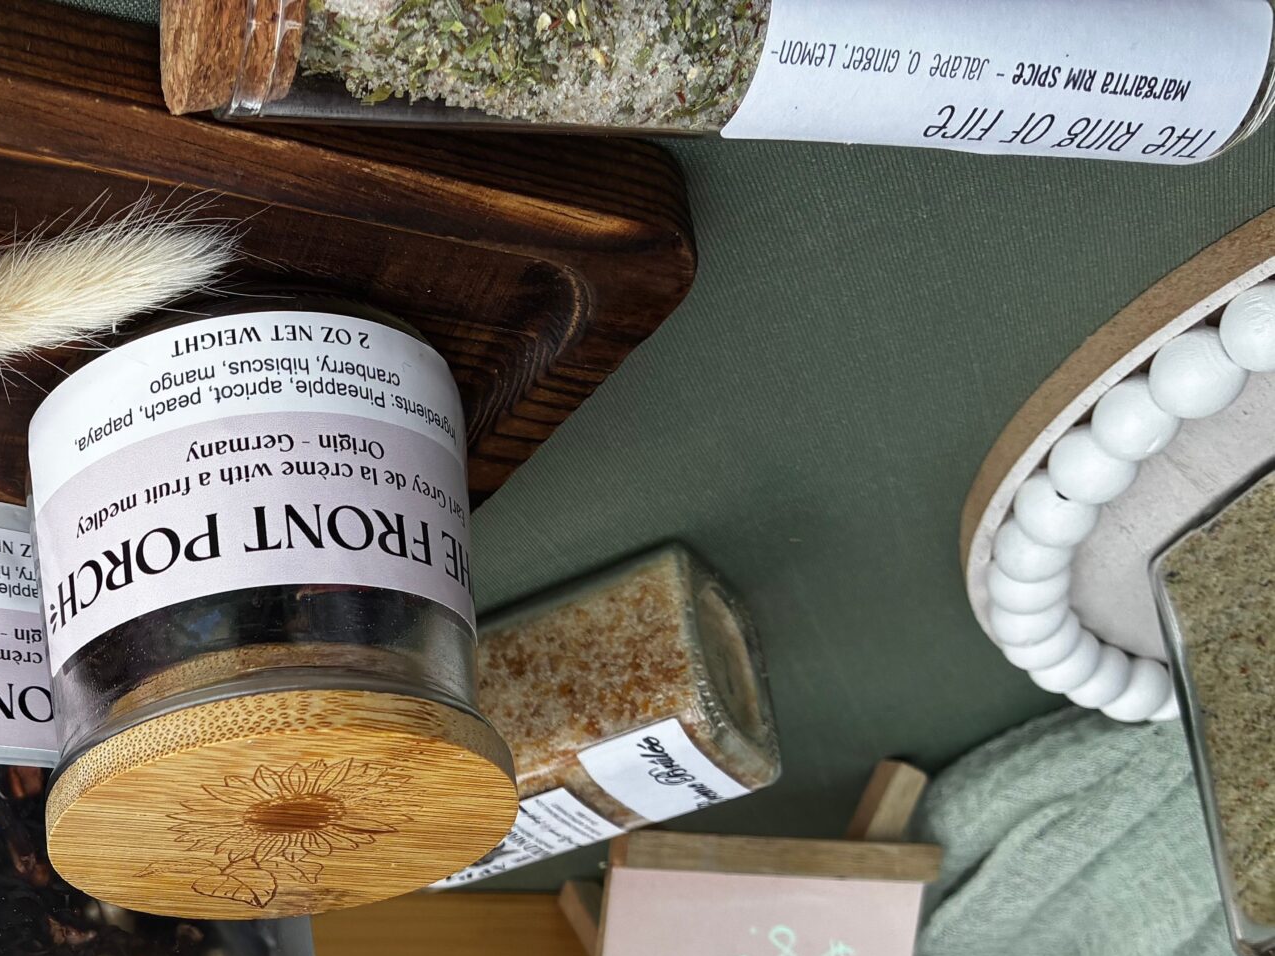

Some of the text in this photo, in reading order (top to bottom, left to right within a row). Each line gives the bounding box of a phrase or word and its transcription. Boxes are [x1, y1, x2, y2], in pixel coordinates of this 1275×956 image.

[170, 324, 370, 358] 2 OZ NET WEIGHT
[149, 355, 401, 395] cranberry, hibiscus, mango
[73, 376, 457, 453] Ingredients: Pineapple, apricot, peach, papaya,
[185, 432, 385, 464] Origin Germany
[75, 461, 466, 541] Earl Grey de la crème with a fruit medley
[57, 504, 433, 628] FRONT PORCH
